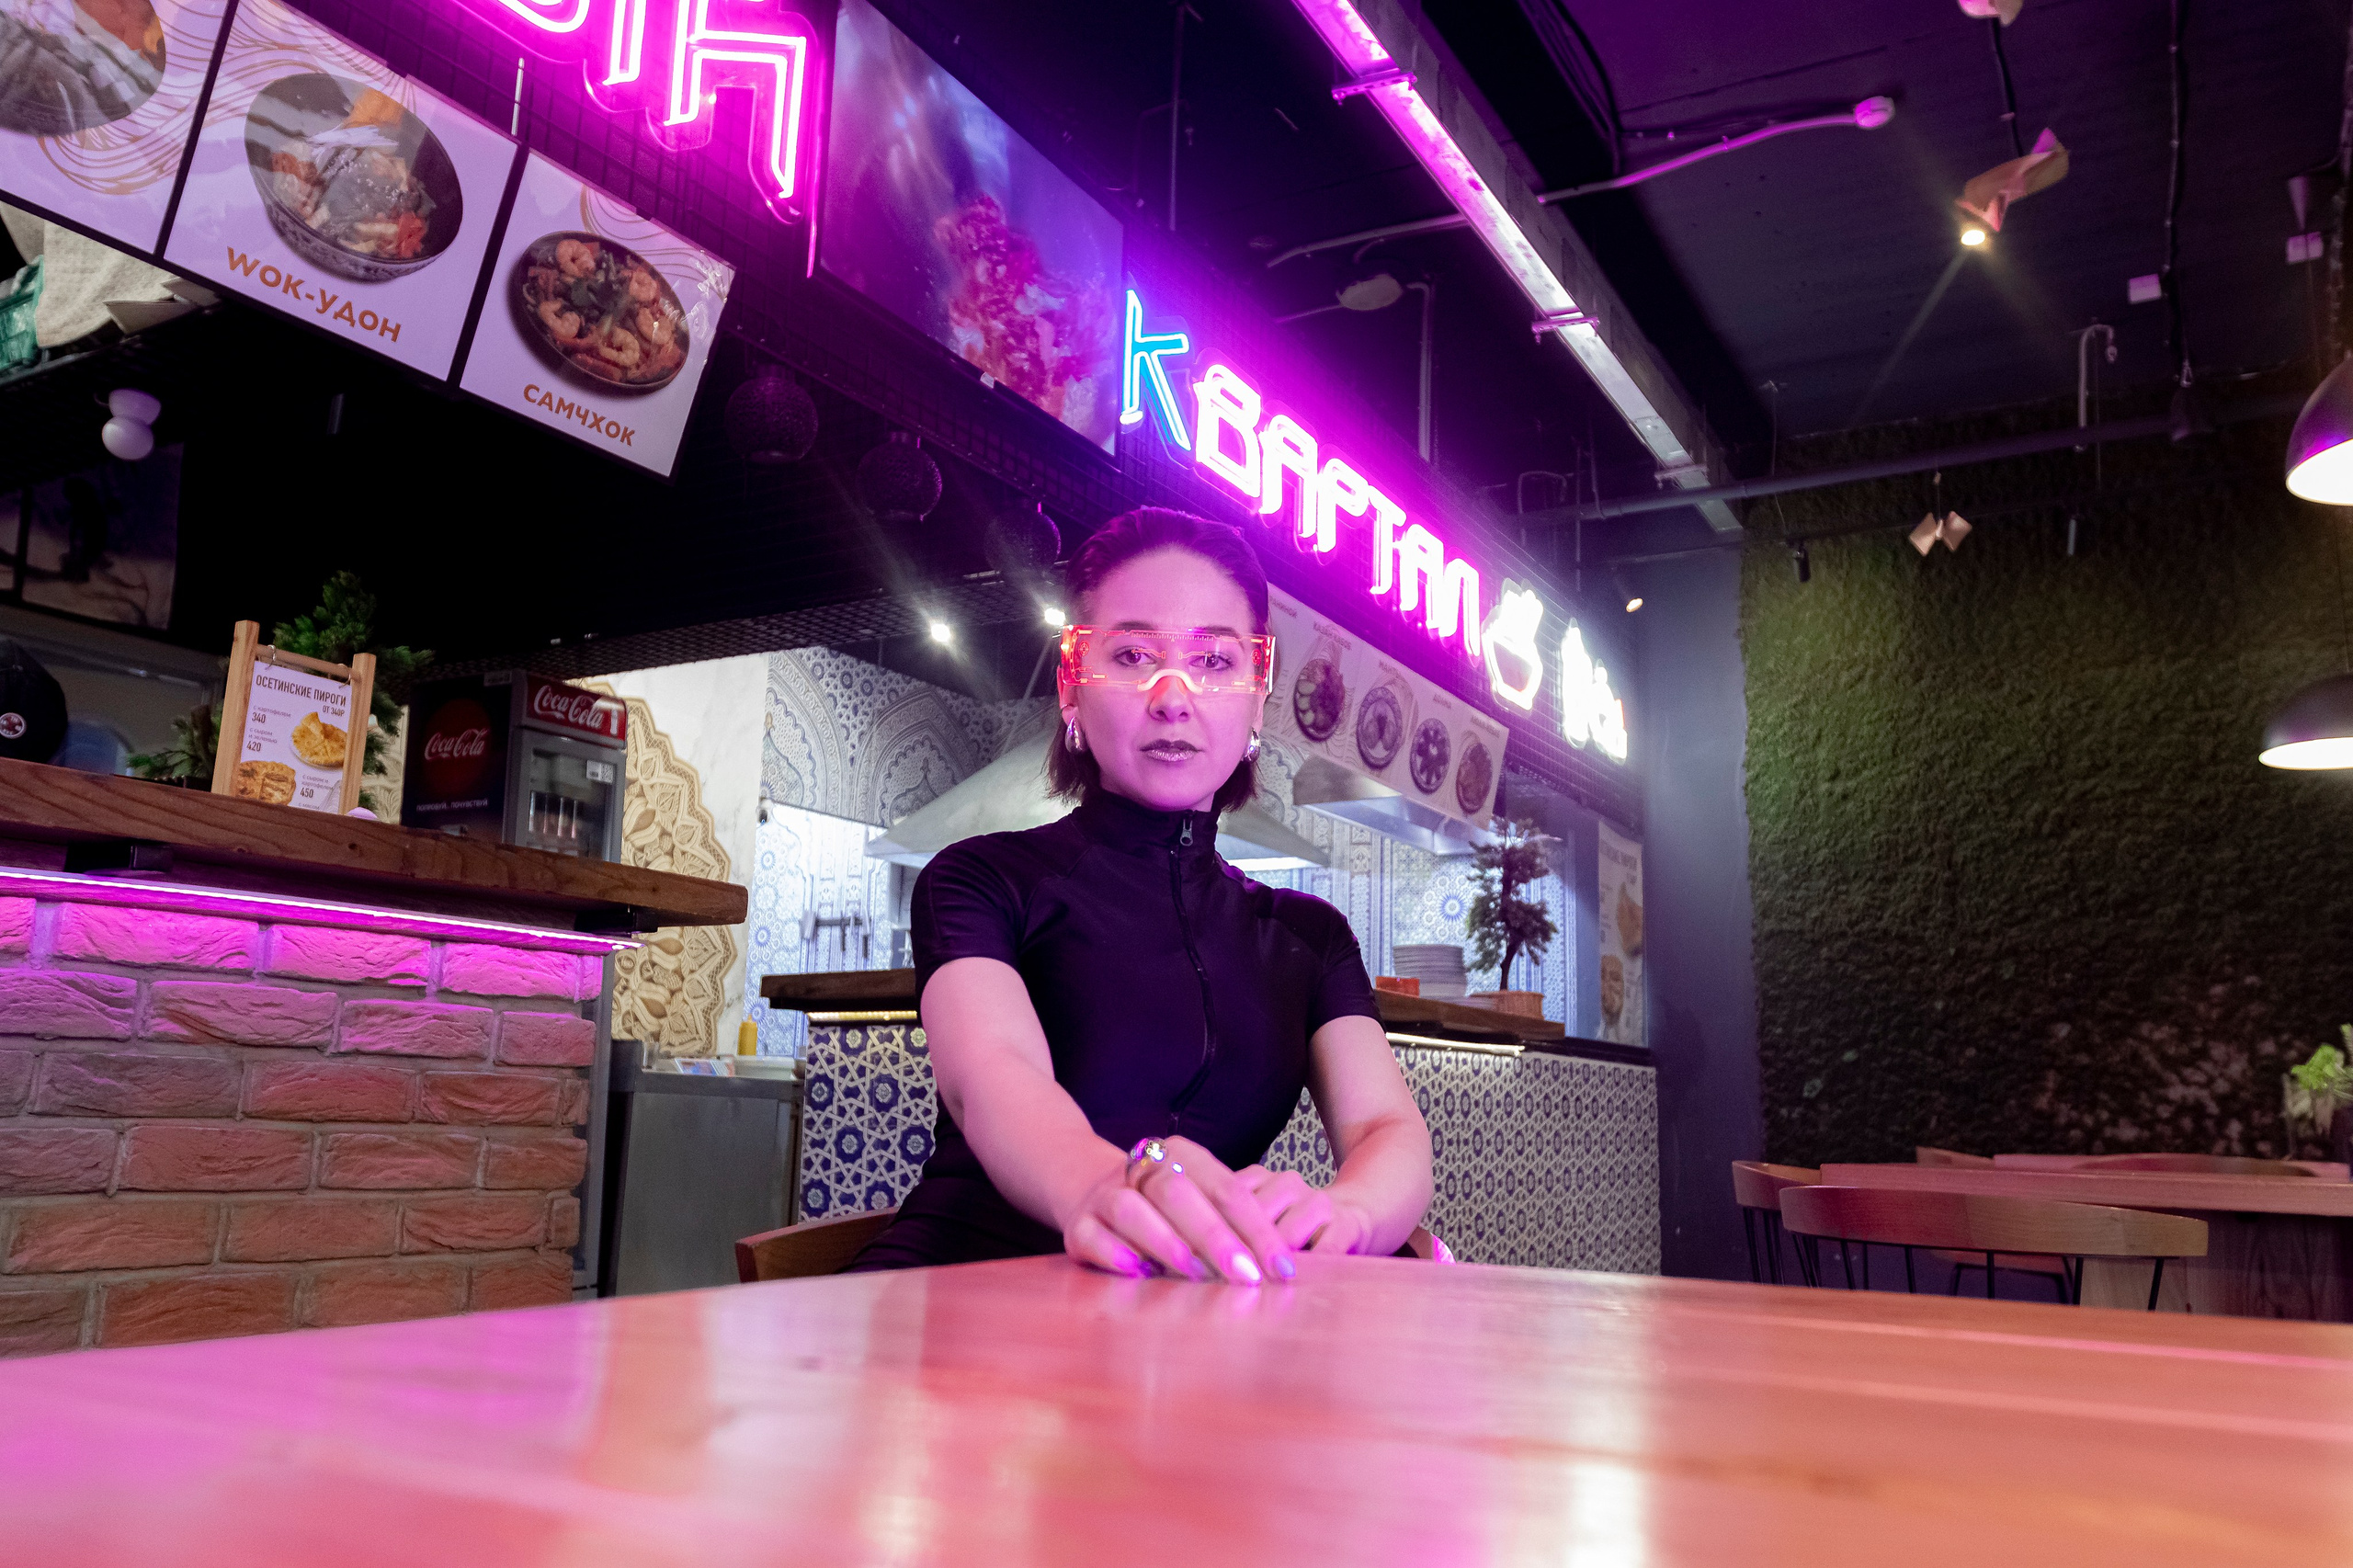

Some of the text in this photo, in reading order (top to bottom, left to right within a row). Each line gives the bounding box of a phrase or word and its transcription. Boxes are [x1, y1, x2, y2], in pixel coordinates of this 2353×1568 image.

[226, 245, 402, 343] WOK-УДОН
[523, 383, 636, 447] САМЧХОК
[256, 675, 347, 707] ОСЕТИНСКИЕ ПИРОГИ
[257, 707, 291, 718] картофелем
[323, 705, 330, 713] ОТ
[251, 711, 267, 724] 340
[254, 728, 273, 736] сыром
[246, 741, 262, 753] 420
[300, 788, 314, 798] 450
